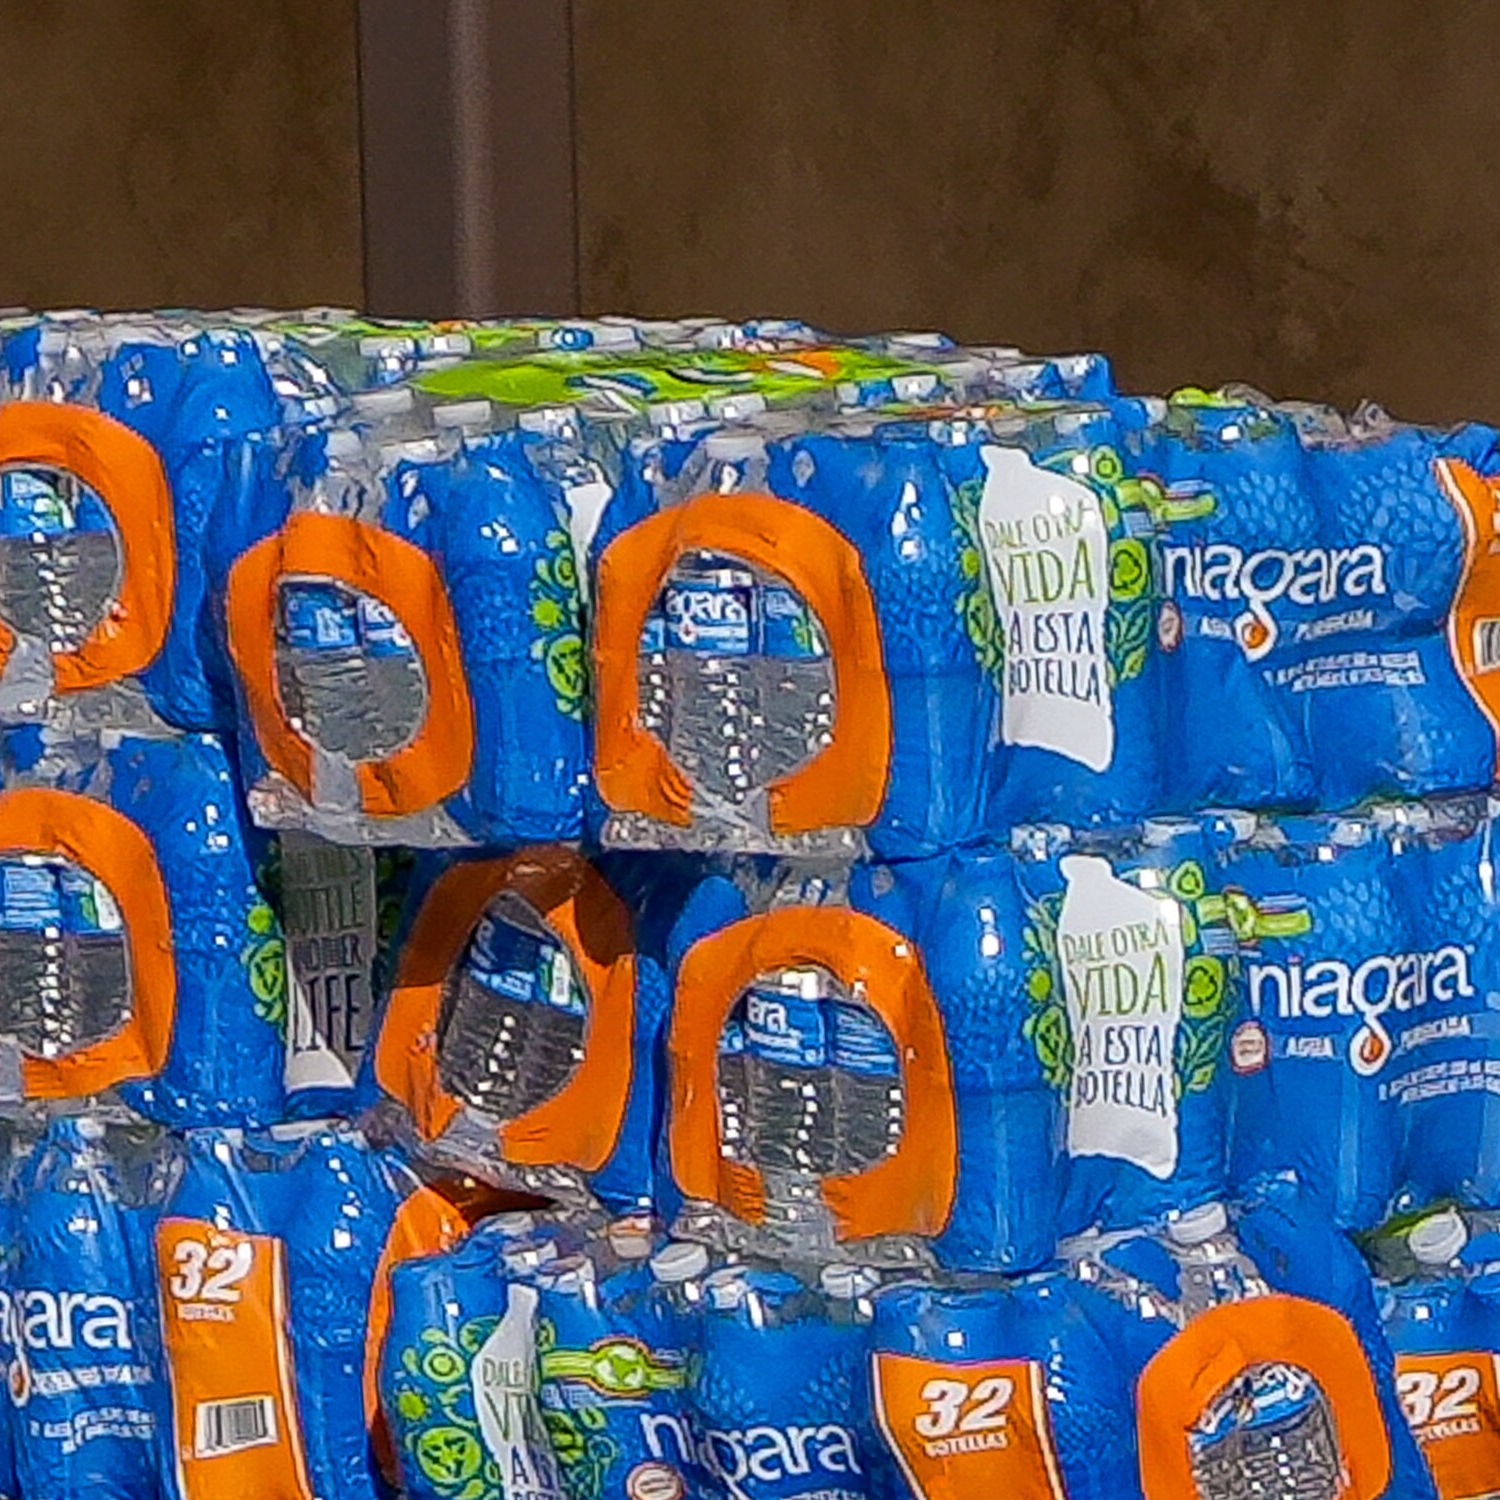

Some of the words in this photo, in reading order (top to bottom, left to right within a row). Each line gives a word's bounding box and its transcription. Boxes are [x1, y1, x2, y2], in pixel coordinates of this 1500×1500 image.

[992, 538, 1095, 606] VIDA
[1162, 542, 1388, 640] niagara
[1008, 611, 1023, 655] A
[1033, 611, 1095, 654] ESTA
[292, 973, 366, 1053] LIFE
[1068, 950, 1168, 1021] VIDA
[1249, 944, 1475, 1053] niagara
[1079, 1024, 1093, 1067] A
[1105, 1024, 1163, 1067] ESTA
[170, 1239, 252, 1302] 32
[914, 1377, 1014, 1437] 32
[1396, 1366, 1481, 1427] 32
